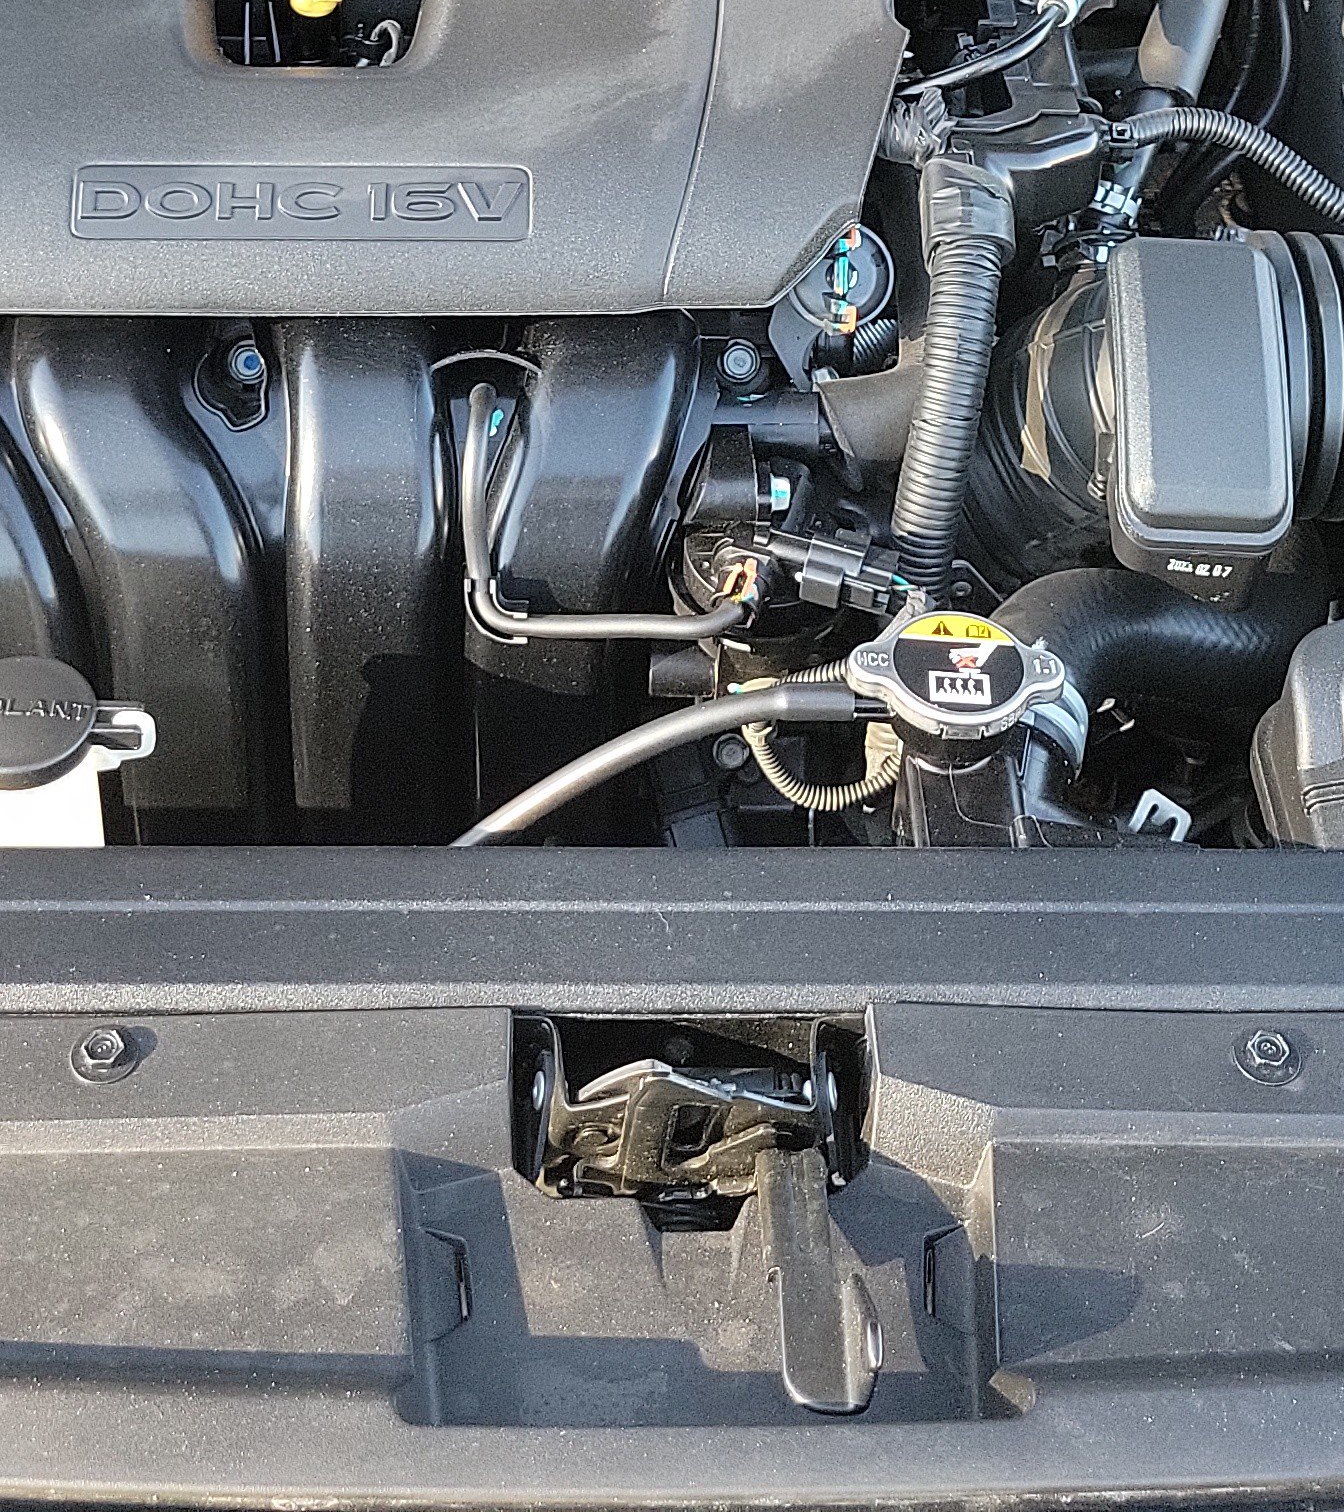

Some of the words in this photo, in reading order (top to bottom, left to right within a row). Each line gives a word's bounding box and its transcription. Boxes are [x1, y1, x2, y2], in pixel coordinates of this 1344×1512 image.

[78, 180, 342, 221] DOHC
[367, 180, 526, 222] 16V
[857, 650, 891, 668] HCC
